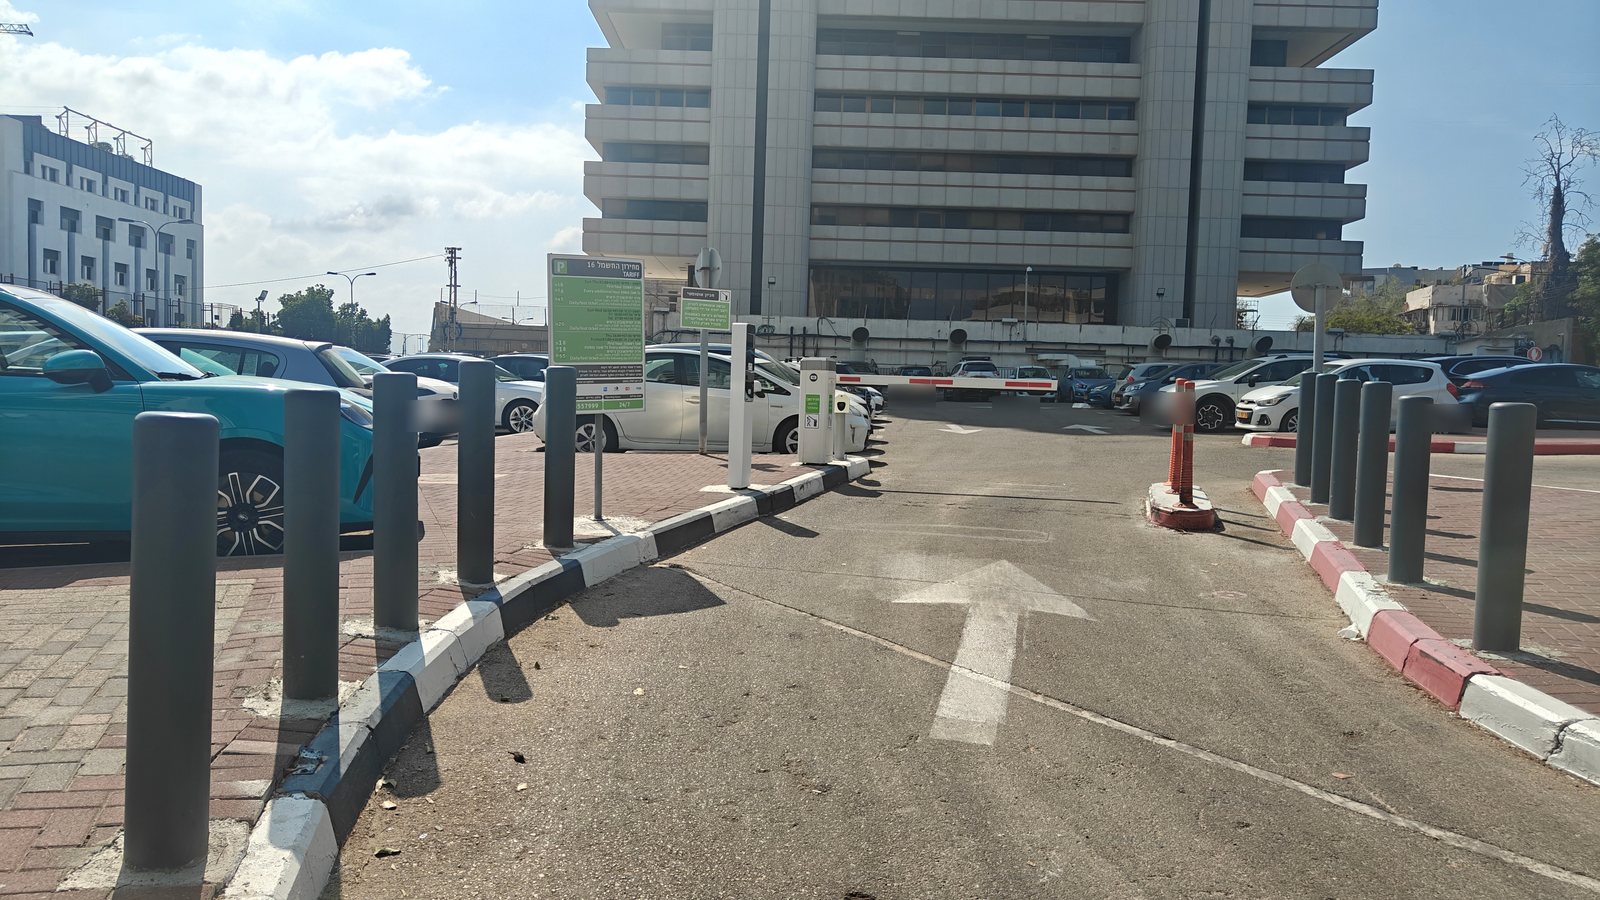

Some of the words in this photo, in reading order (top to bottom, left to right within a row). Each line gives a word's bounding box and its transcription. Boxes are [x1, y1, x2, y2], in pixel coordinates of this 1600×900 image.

[557, 261, 565, 273] P
[597, 261, 620, 269] החשמל
[621, 263, 640, 271] מחירון
